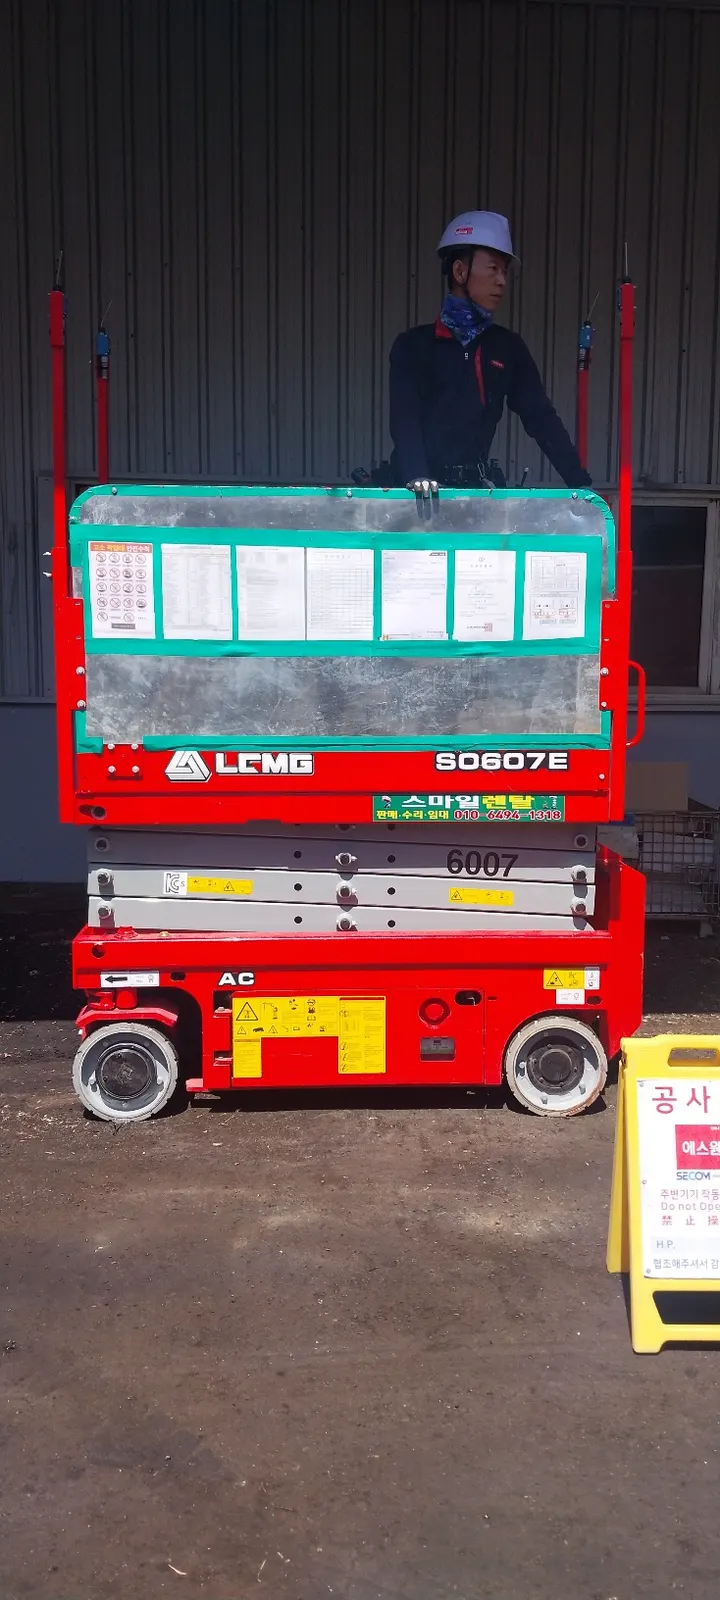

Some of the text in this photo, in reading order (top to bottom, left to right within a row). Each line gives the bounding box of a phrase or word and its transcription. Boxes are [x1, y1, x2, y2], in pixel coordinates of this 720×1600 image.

[454, 810, 562, 820] 010-6494-1318
[446, 848, 519, 877] 6007
[218, 972, 255, 986] AC
[676, 1172, 711, 1180] SECOM
[660, 1189, 698, 1200] 주변기기
[661, 1202, 675, 1211] Do
[679, 1203, 697, 1211] not
[653, 1259, 708, 1269] 협조해주셔서
